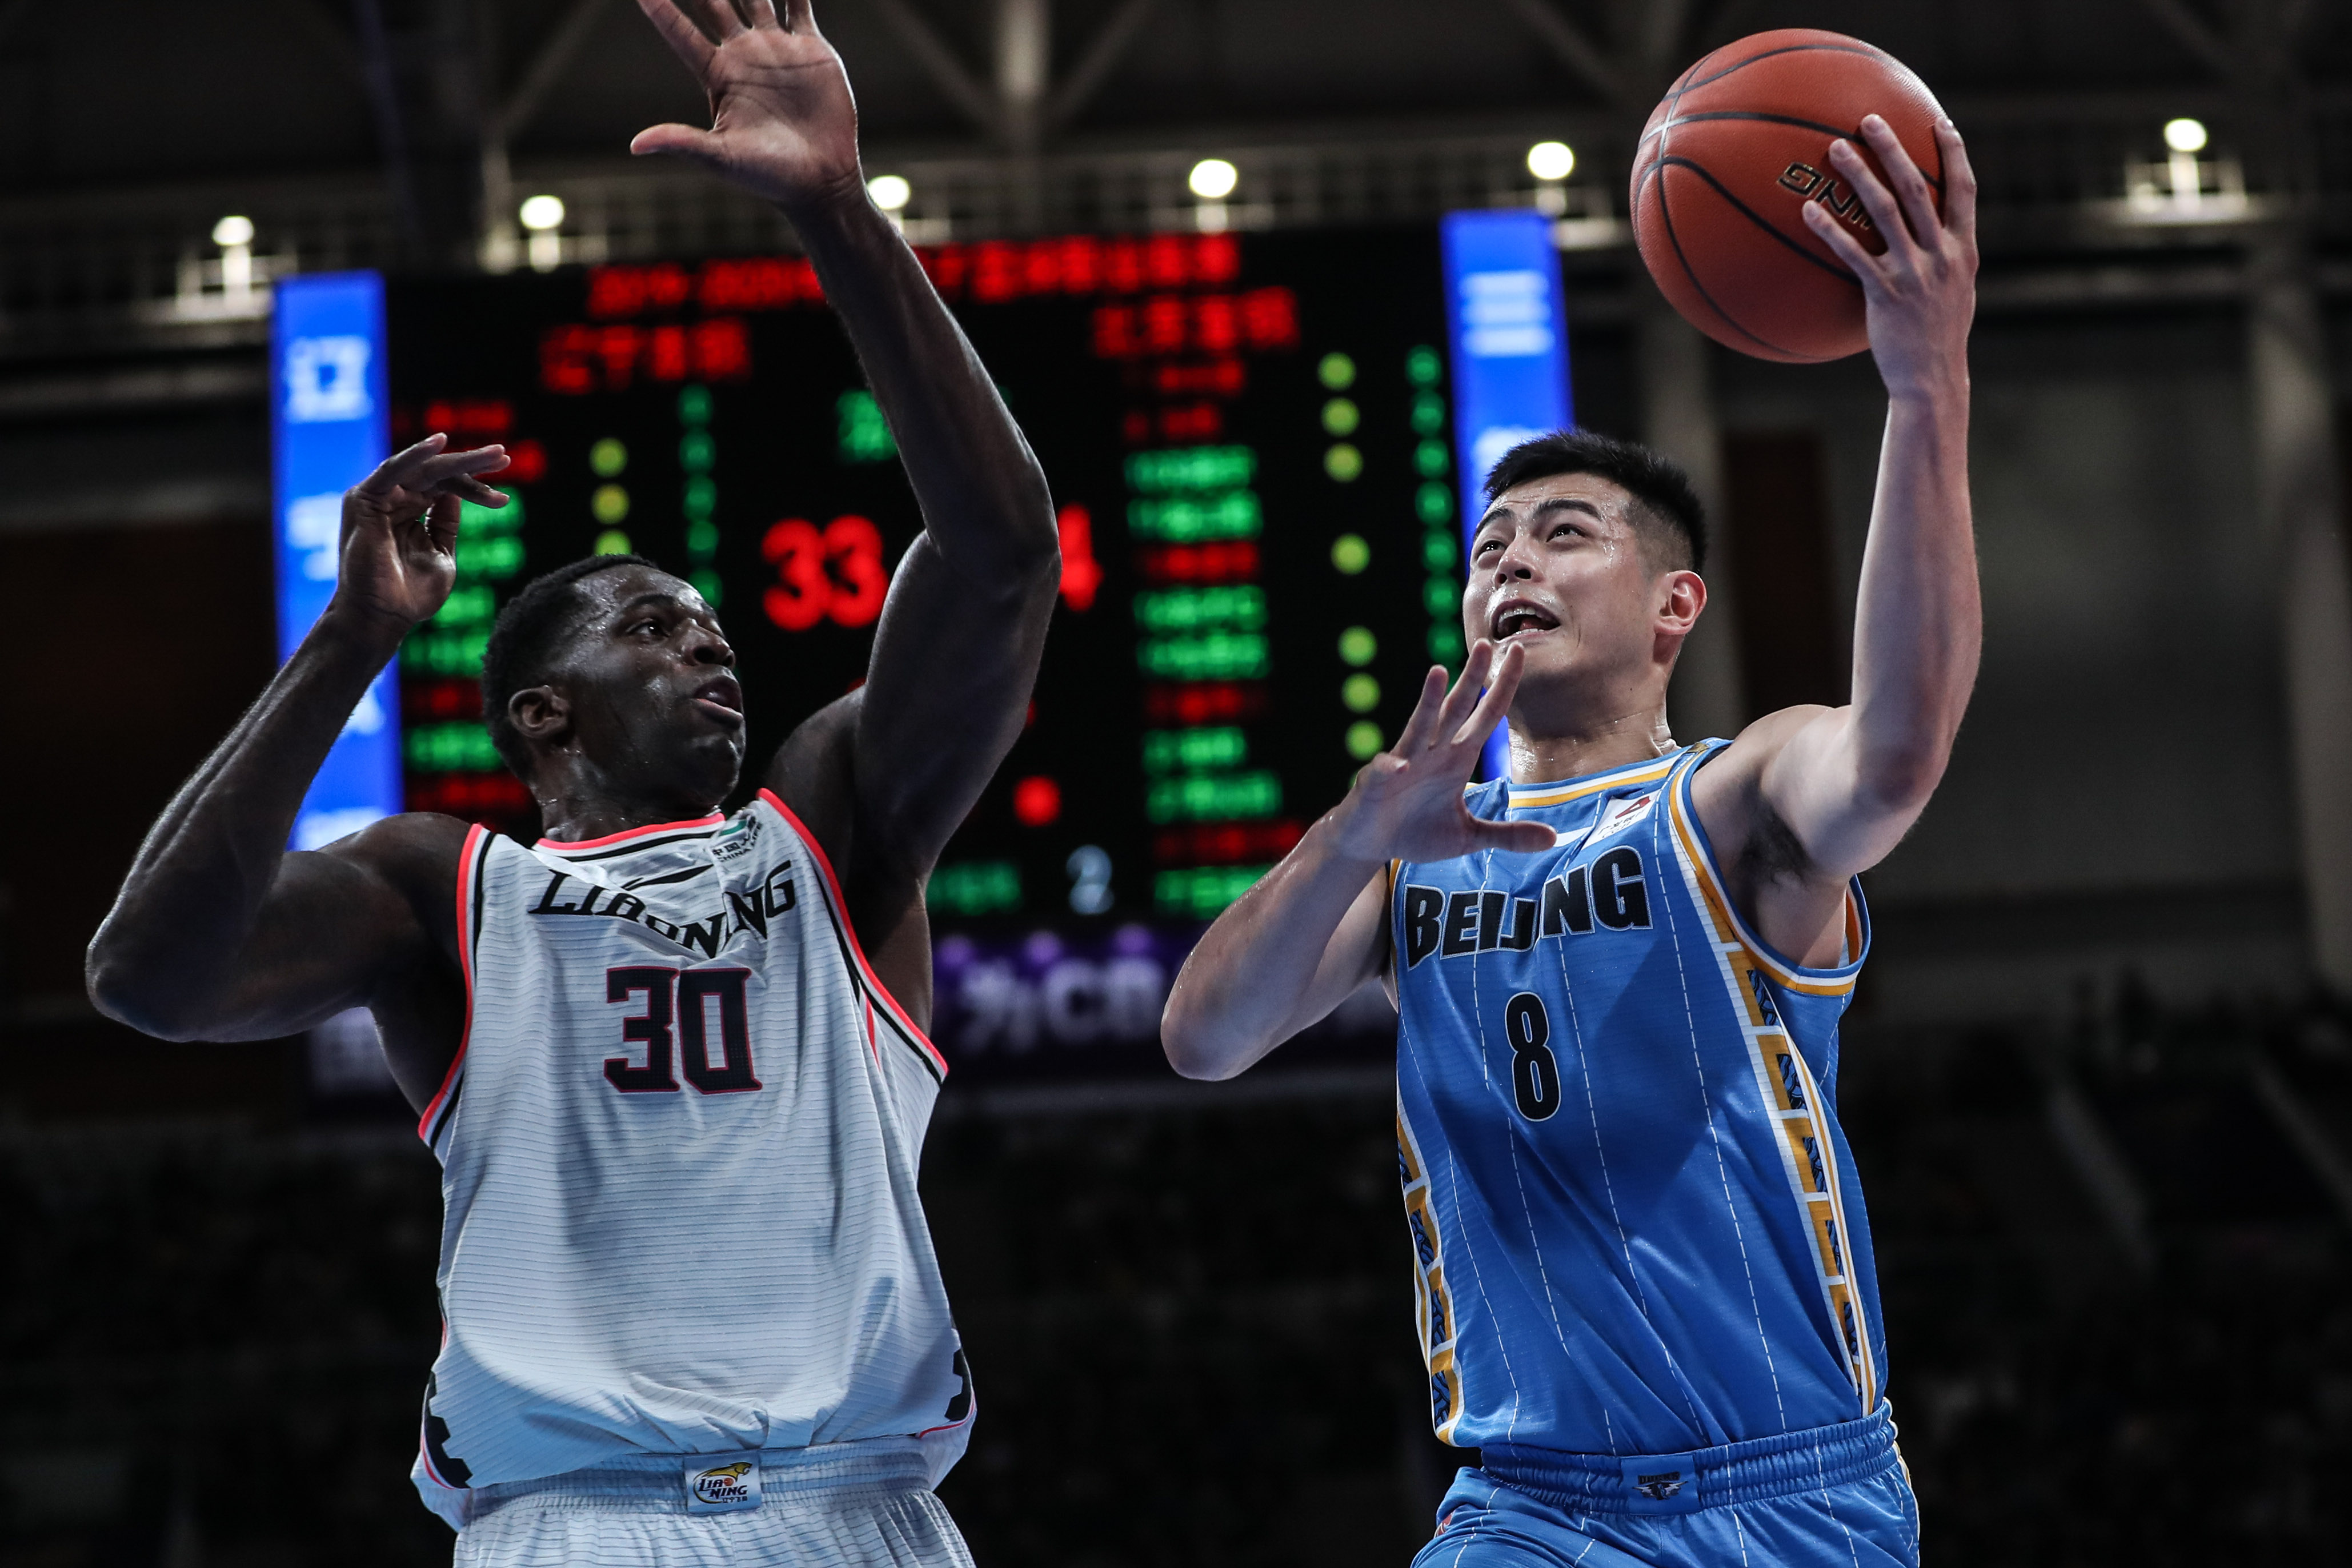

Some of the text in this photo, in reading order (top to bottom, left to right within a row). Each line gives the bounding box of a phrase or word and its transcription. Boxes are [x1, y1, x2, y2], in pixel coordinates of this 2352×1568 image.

[762, 517, 888, 630] 33
[528, 860, 796, 959] LIAONNG
[717, 848, 752, 863] CHINA
[1404, 845, 1653, 972] BEIJNG
[604, 965, 763, 1094] 30
[1505, 992, 1561, 1122] 8
